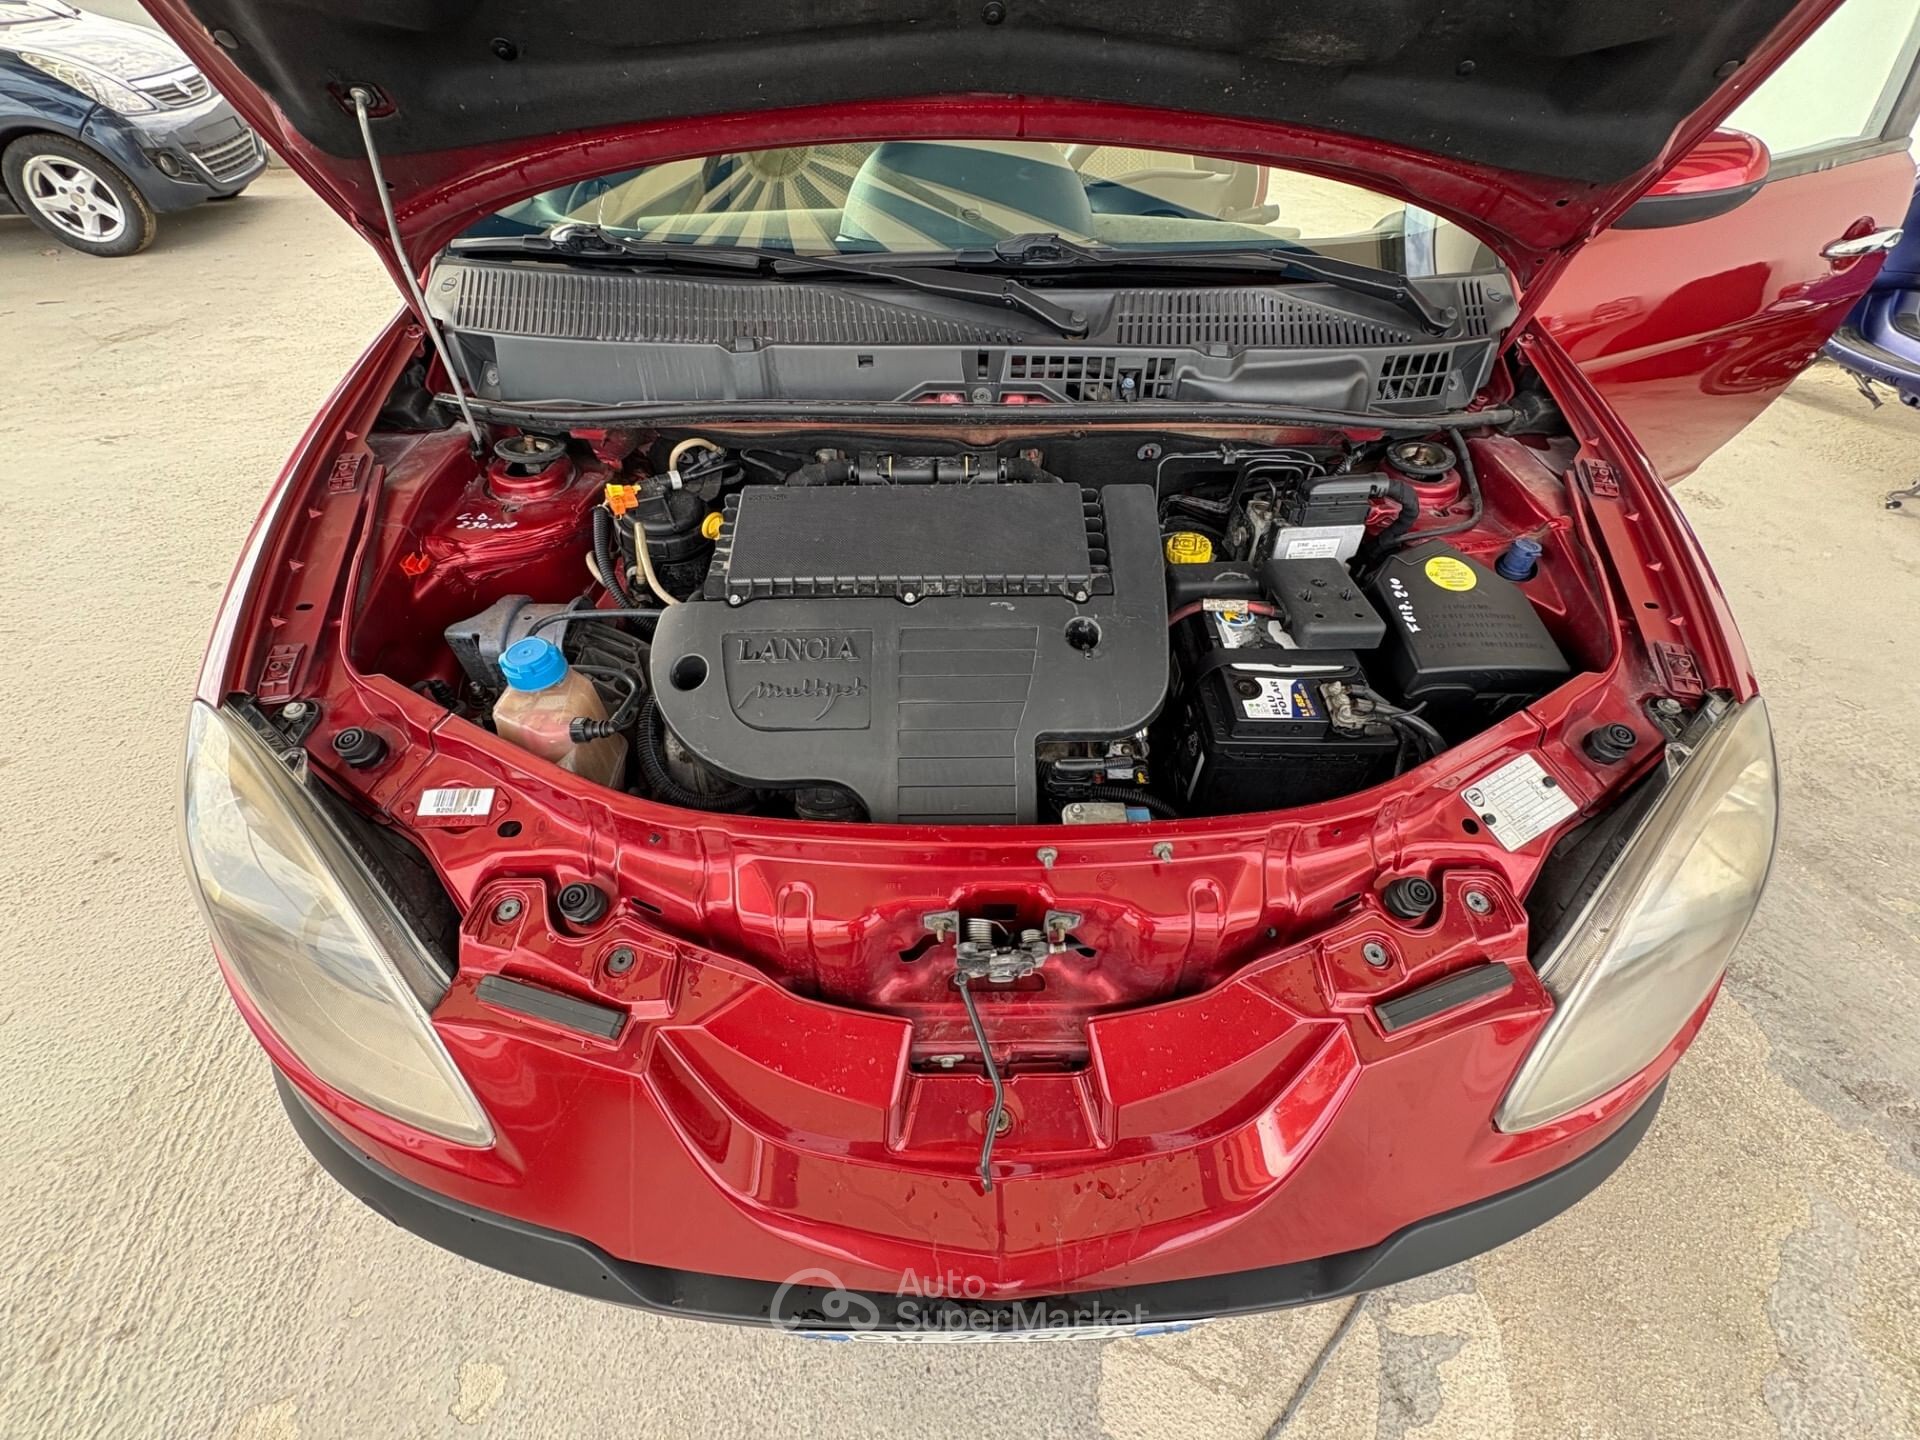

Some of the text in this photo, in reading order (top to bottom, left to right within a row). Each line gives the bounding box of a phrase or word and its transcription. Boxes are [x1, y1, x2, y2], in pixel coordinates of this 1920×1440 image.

[736, 635, 862, 664] LANCIA
[1267, 694, 1281, 716] BLU
[1270, 681, 1290, 716] POLAR
